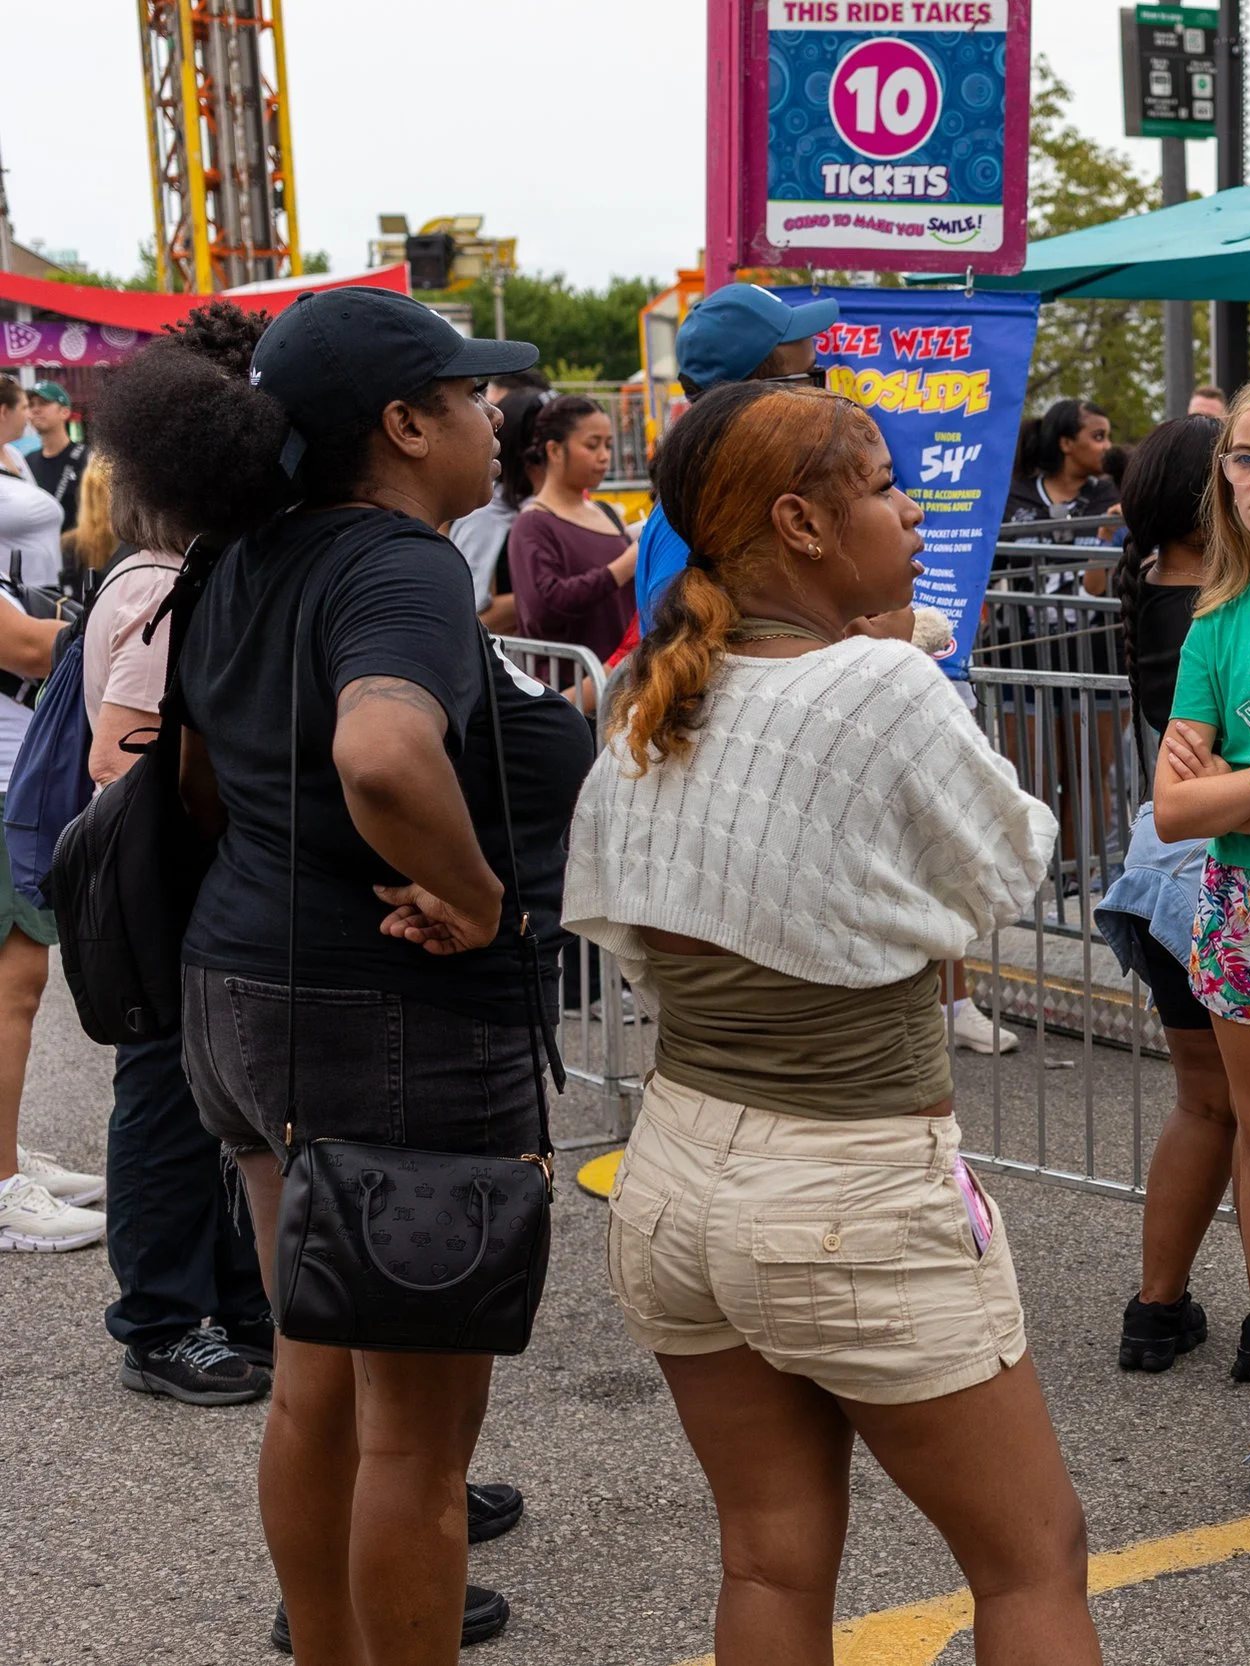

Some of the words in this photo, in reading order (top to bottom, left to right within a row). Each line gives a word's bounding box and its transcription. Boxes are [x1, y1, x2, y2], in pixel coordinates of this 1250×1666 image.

[784, 2, 838, 22] THIS
[847, 2, 904, 22] RIDE
[911, 2, 992, 23] TAKES
[844, 66, 927, 136] 10
[821, 163, 950, 198] TICKETS
[784, 214, 830, 232] GOING
[832, 214, 851, 227] TO
[853, 213, 894, 234] MAKE
[896, 222, 925, 237] YOU
[927, 214, 982, 234] SMILE!
[813, 322, 882, 358] SIZE
[890, 325, 972, 362] WIZE
[934, 432, 962, 442] UNDER
[923, 489, 933, 499] BE
[934, 489, 982, 499] ACCOMPANIED
[926, 501, 952, 512] PAYING
[952, 501, 973, 511] ADULT
[927, 529, 950, 539] POCKET
[950, 529, 959, 538] OF
[959, 528, 971, 537] THE
[933, 543, 954, 553] GOING
[954, 543, 973, 552] DOWN
[919, 592, 936, 604] THIS
[936, 596, 953, 607] RIDE
[953, 598, 968, 607] MAY
